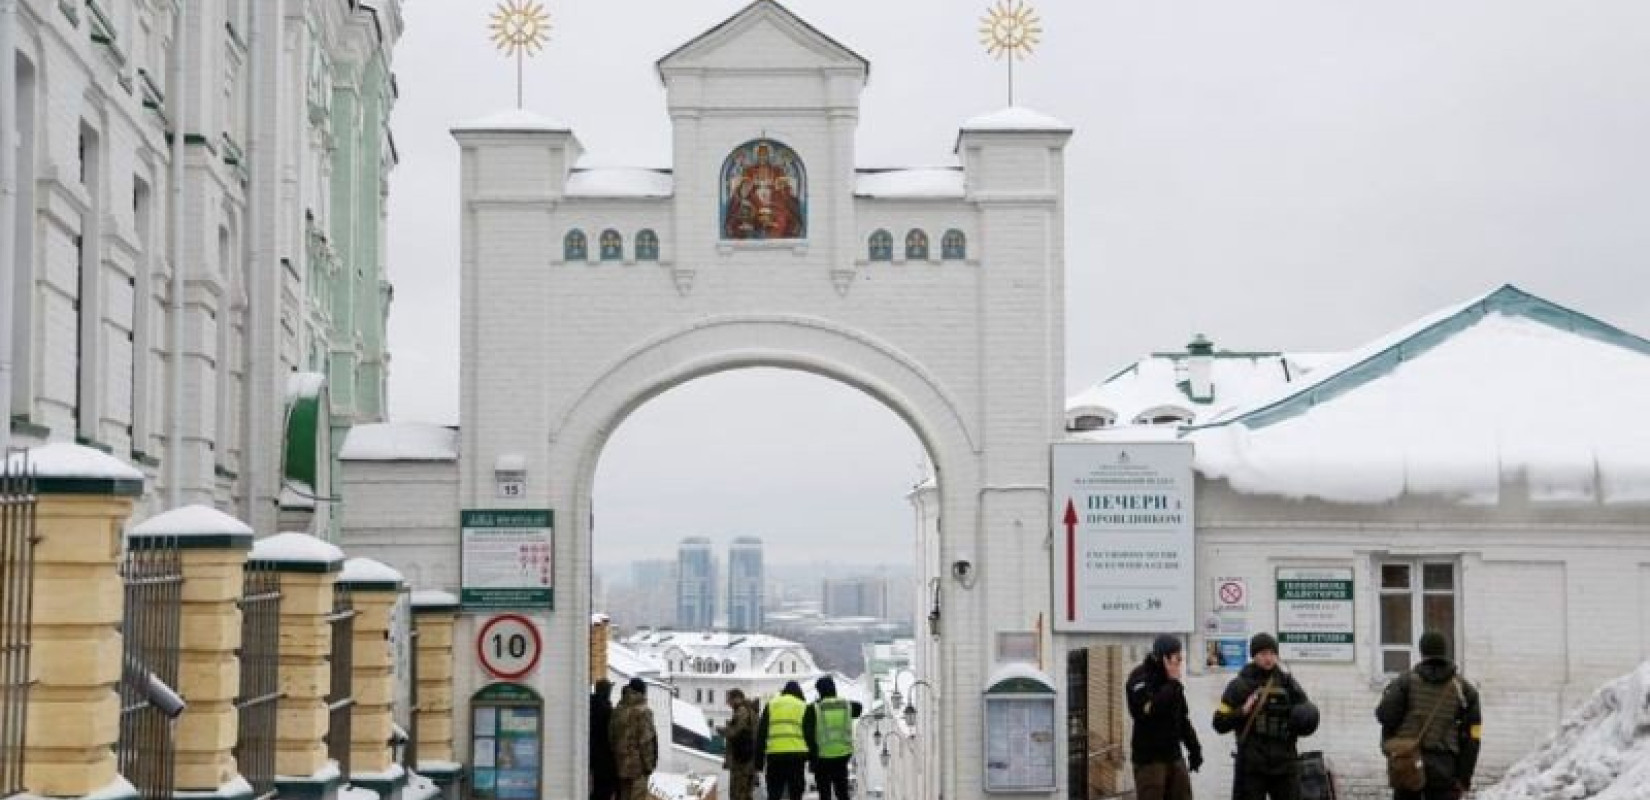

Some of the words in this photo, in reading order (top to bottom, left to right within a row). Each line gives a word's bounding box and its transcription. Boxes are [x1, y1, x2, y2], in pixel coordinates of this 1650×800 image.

[504, 485, 519, 495] 15
[1087, 495, 1167, 509] ПЕЧЕРИ
[493, 633, 526, 659] 10
